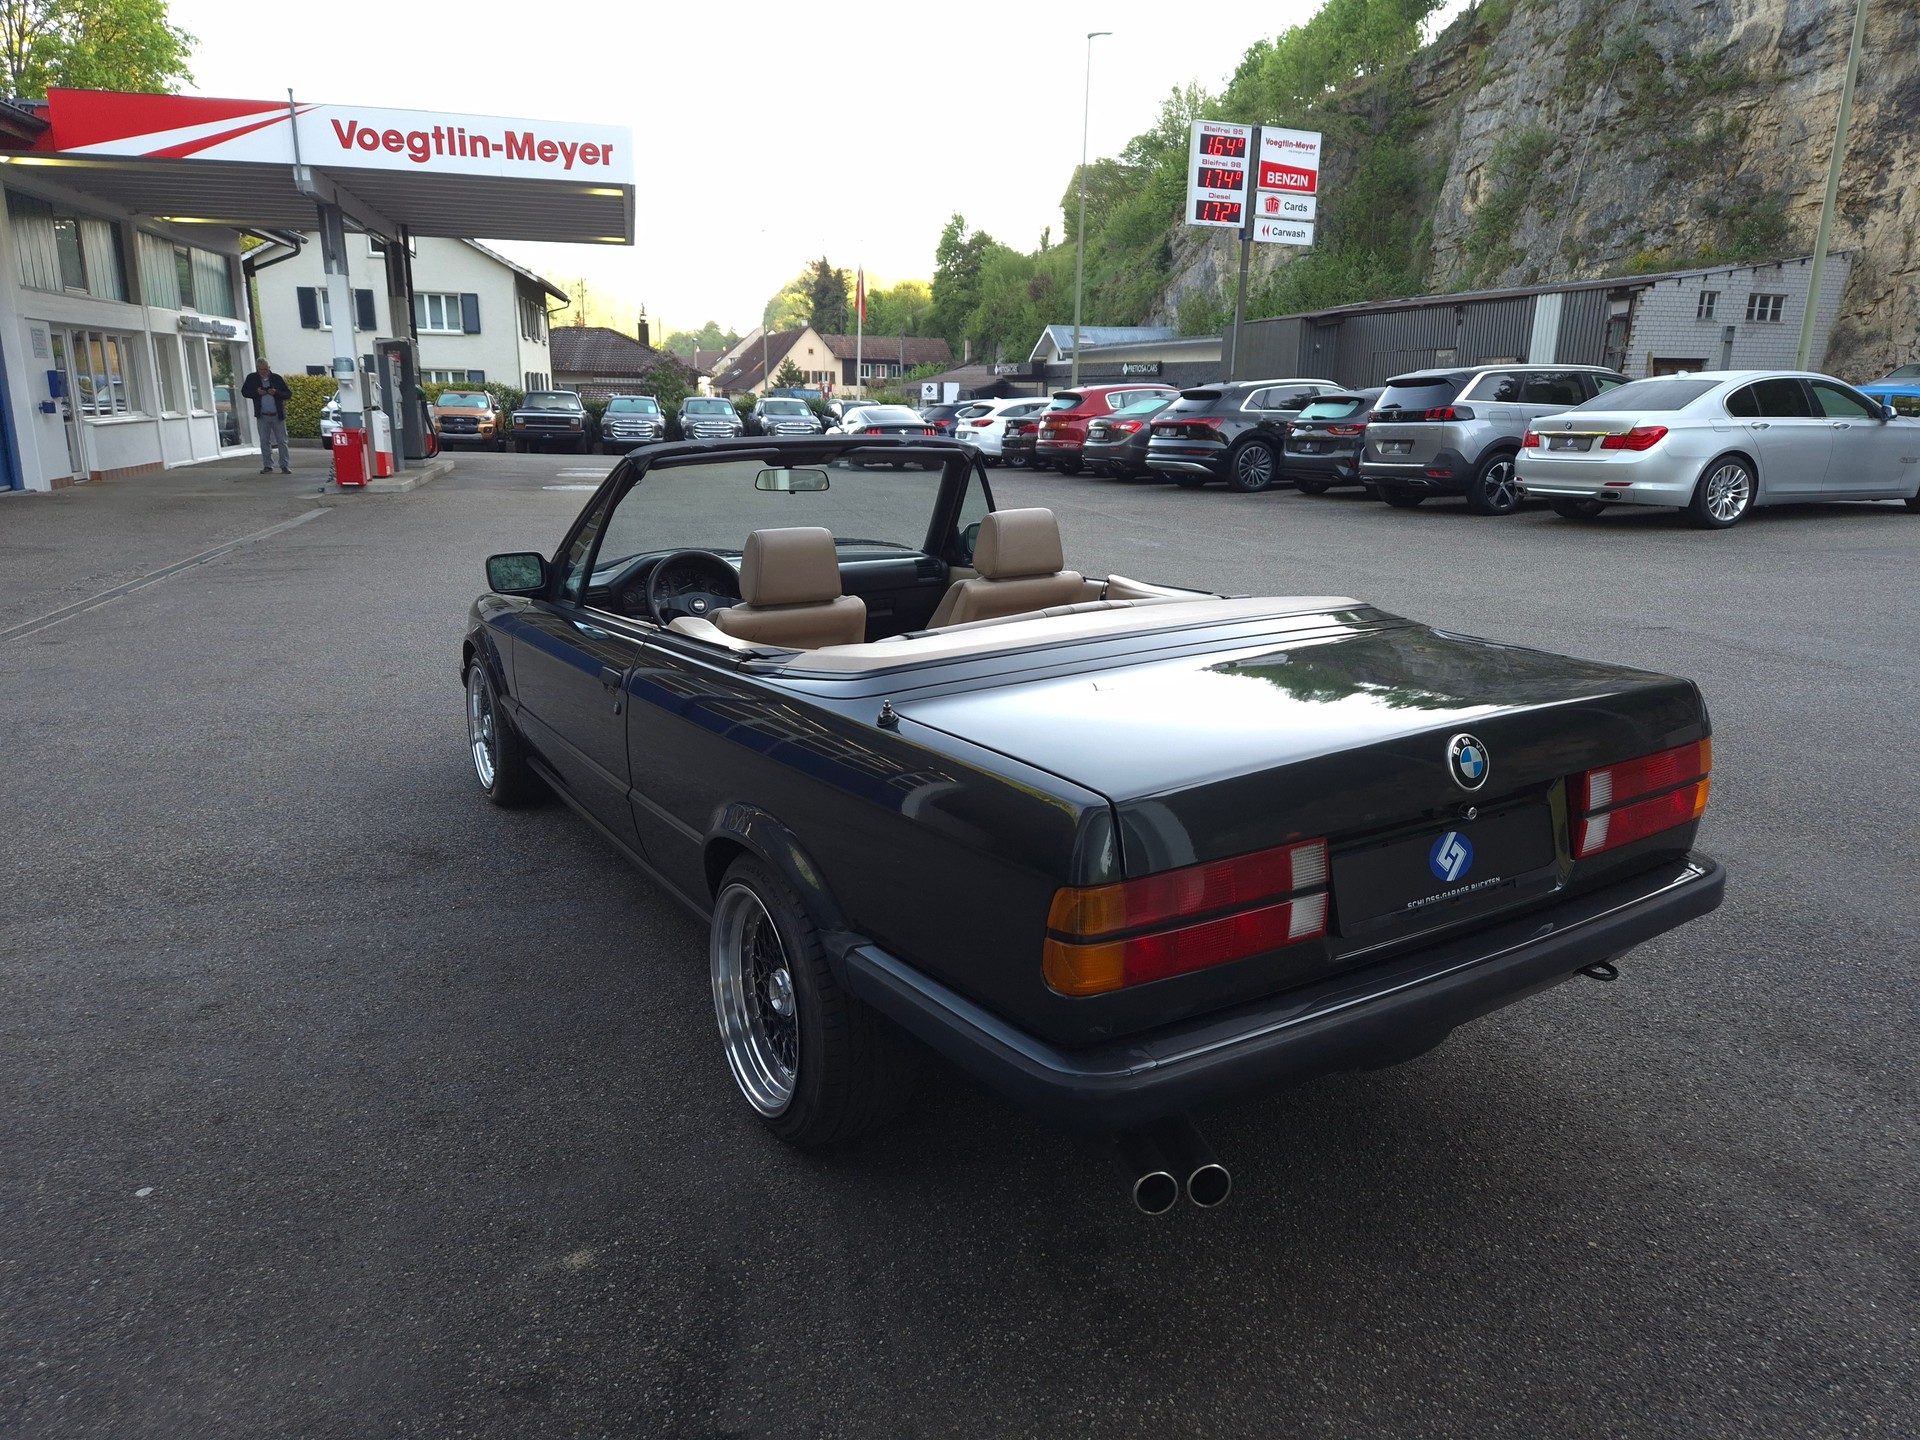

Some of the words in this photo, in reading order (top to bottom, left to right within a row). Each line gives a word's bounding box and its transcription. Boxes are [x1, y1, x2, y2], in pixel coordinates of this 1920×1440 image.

[1203, 125, 1231, 134] Bleifrei
[1232, 128, 1244, 136] 95
[331, 119, 614, 170] Voegtlin-Meyer
[1265, 137, 1317, 151] Voegtlin-Meyer
[1201, 158, 1229, 168] Bleifrei
[1230, 161, 1242, 169] 98
[1266, 171, 1309, 188] BENZIN
[1208, 192, 1231, 200] Diesel
[1284, 201, 1308, 213] Cards
[1272, 226, 1306, 238] Carwash
[1452, 737, 1484, 757] BMW
